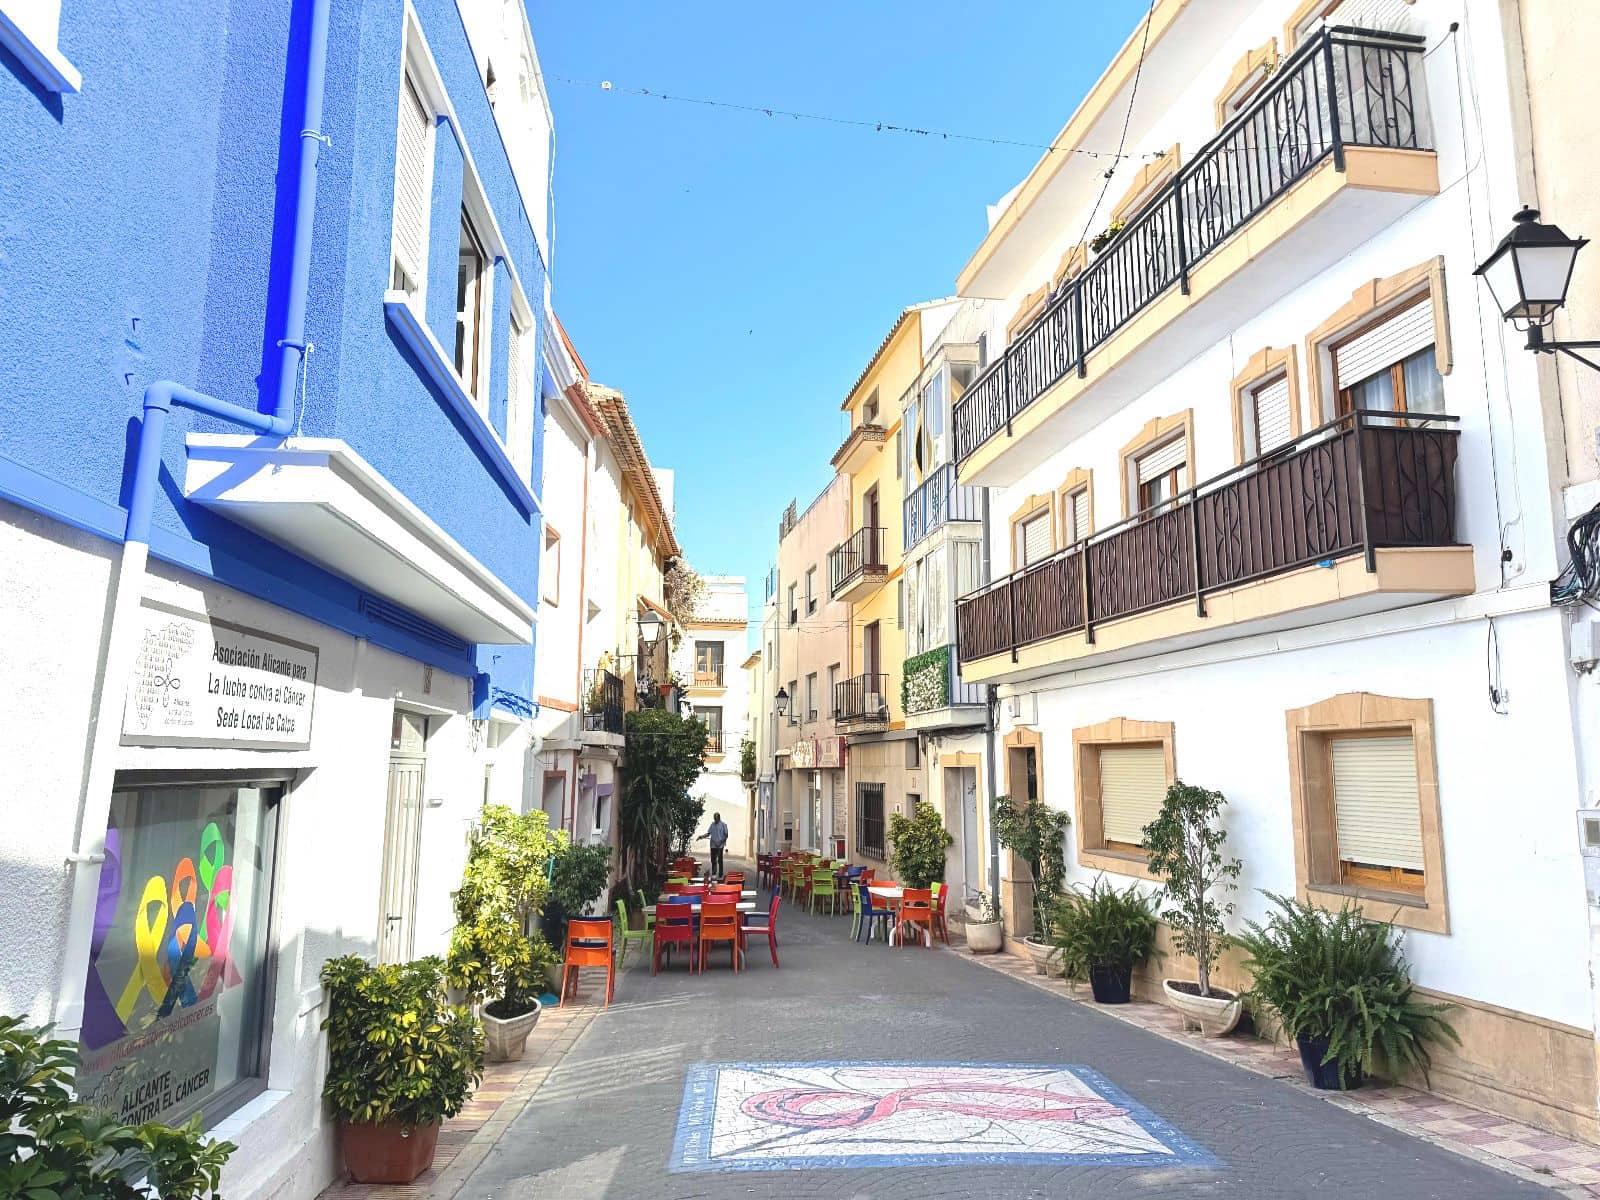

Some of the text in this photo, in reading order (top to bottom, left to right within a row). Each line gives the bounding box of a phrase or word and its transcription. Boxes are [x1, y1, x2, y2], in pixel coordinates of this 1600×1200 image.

[212, 641, 307, 681] Asociación Alicante para
[208, 672, 220, 694] La
[222, 674, 247, 698] lucha
[249, 683, 273, 702] contra
[274, 685, 282, 703] el
[216, 706, 239, 728] Sede
[241, 709, 265, 731] Local
[265, 712, 275, 731] de
[276, 713, 296, 736] Calpe
[121, 1070, 171, 1116] ALICANTE
[162, 1092, 174, 1111] EL
[175, 1069, 210, 1102] CÁNCER
